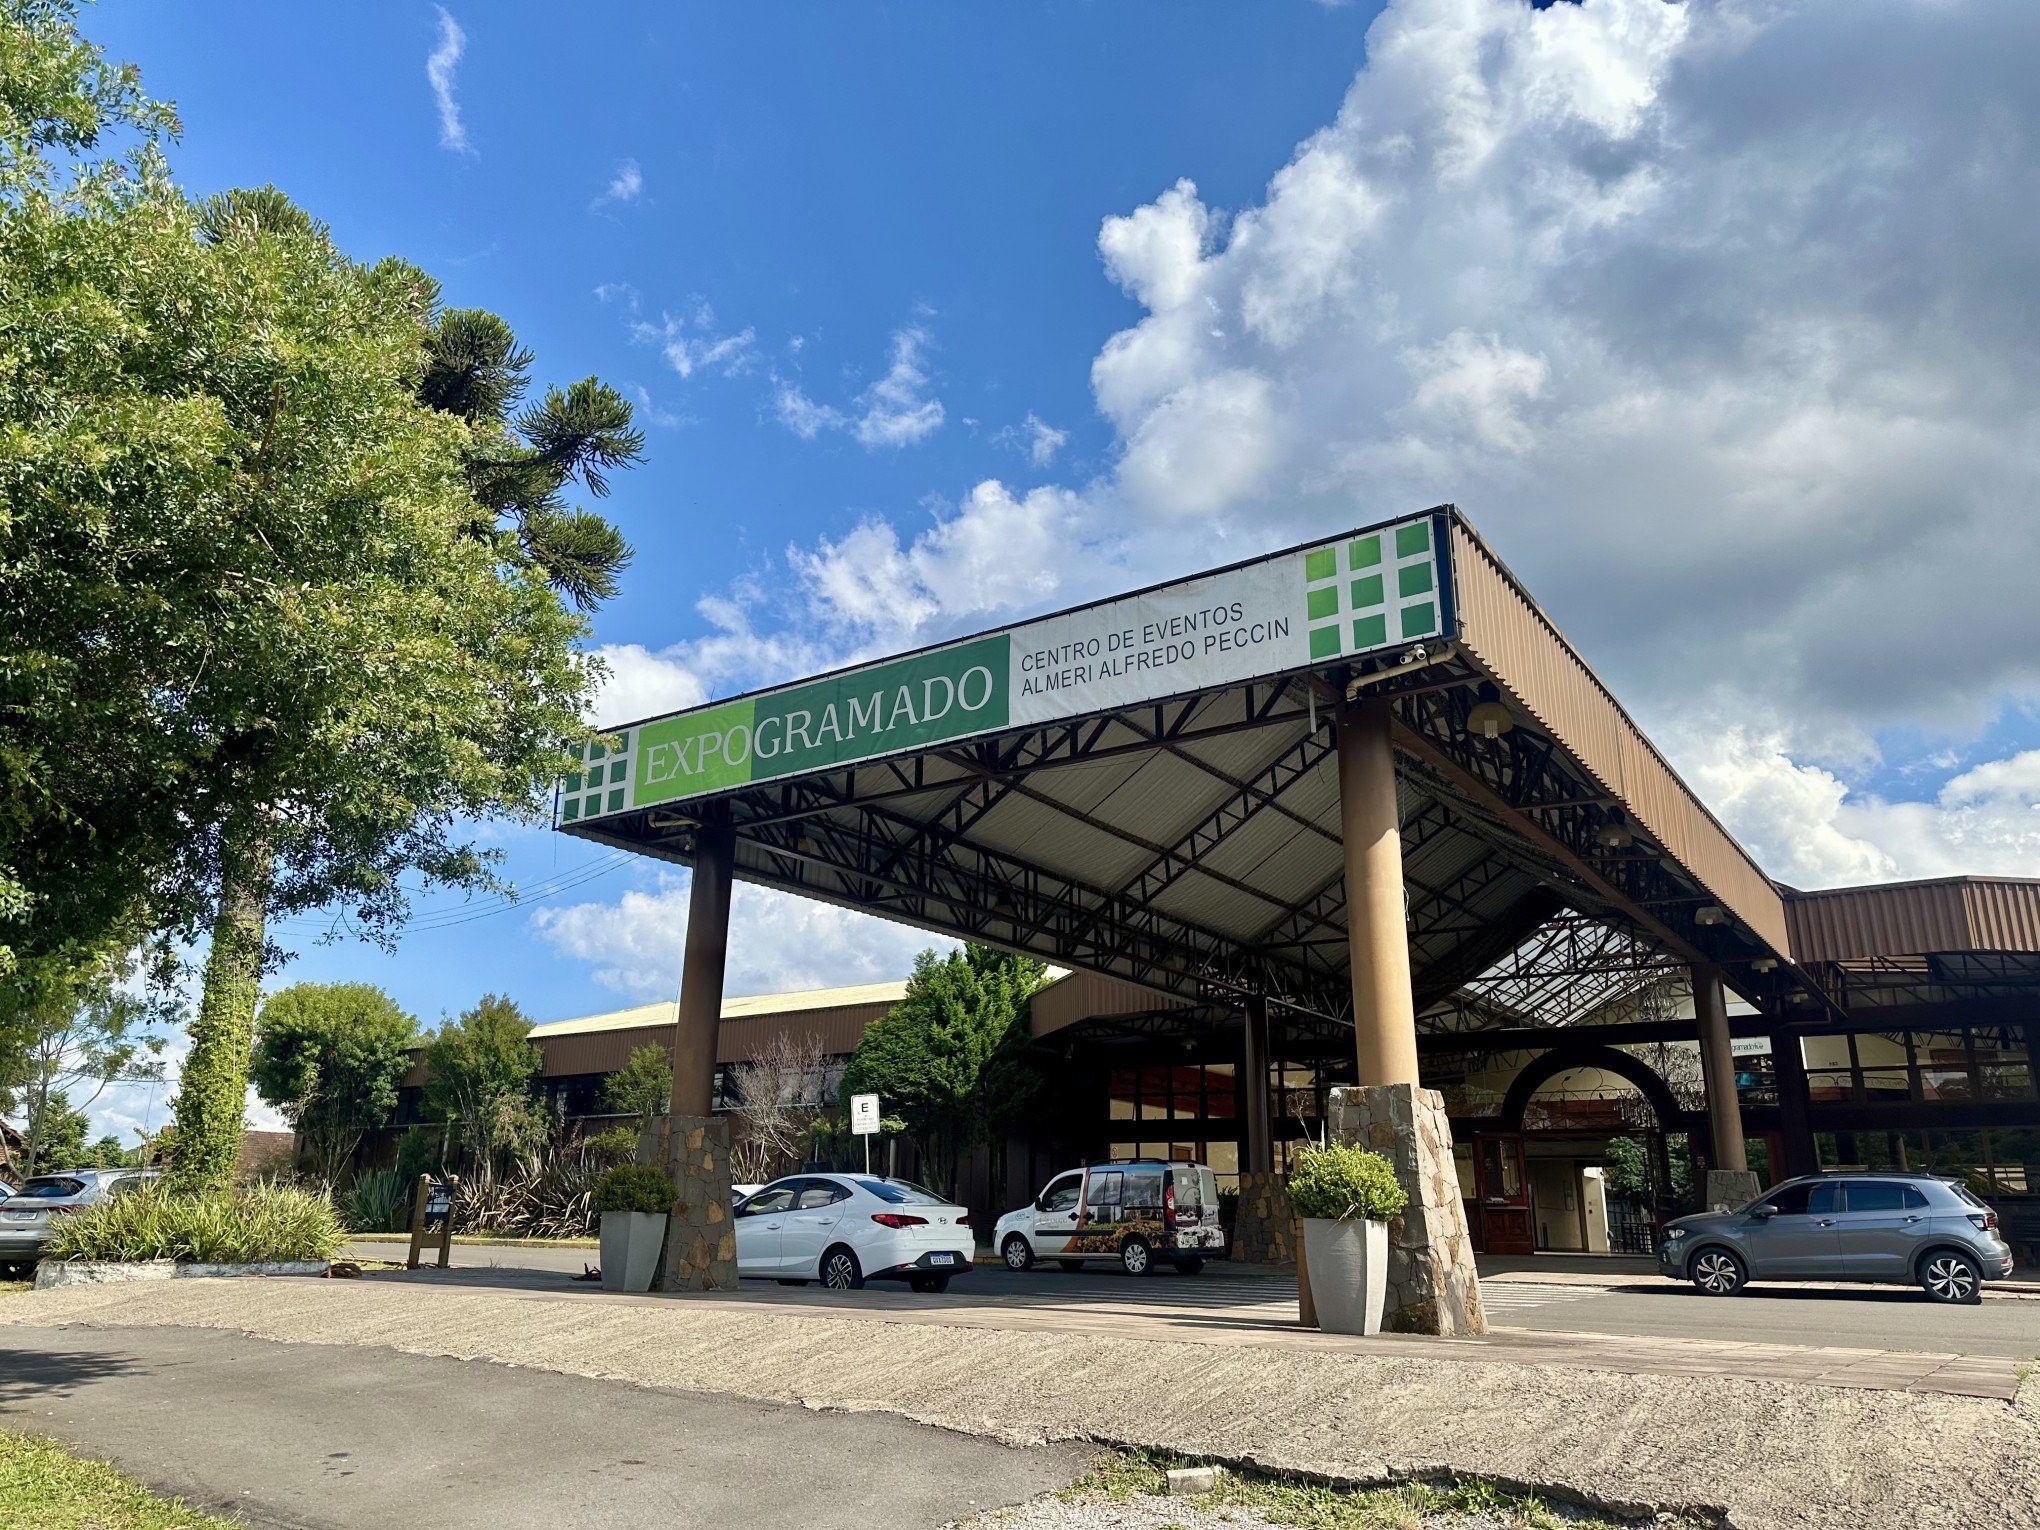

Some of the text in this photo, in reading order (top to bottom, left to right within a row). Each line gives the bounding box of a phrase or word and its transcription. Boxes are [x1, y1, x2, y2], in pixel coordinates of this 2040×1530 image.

[1021, 602, 1244, 672] CENTRO DE EVENTOS
[1021, 616, 1290, 697] ALMERI ALFREDO PECCIN
[644, 665, 993, 785] EXPOGRAMADO
[861, 1102, 869, 1113] E
